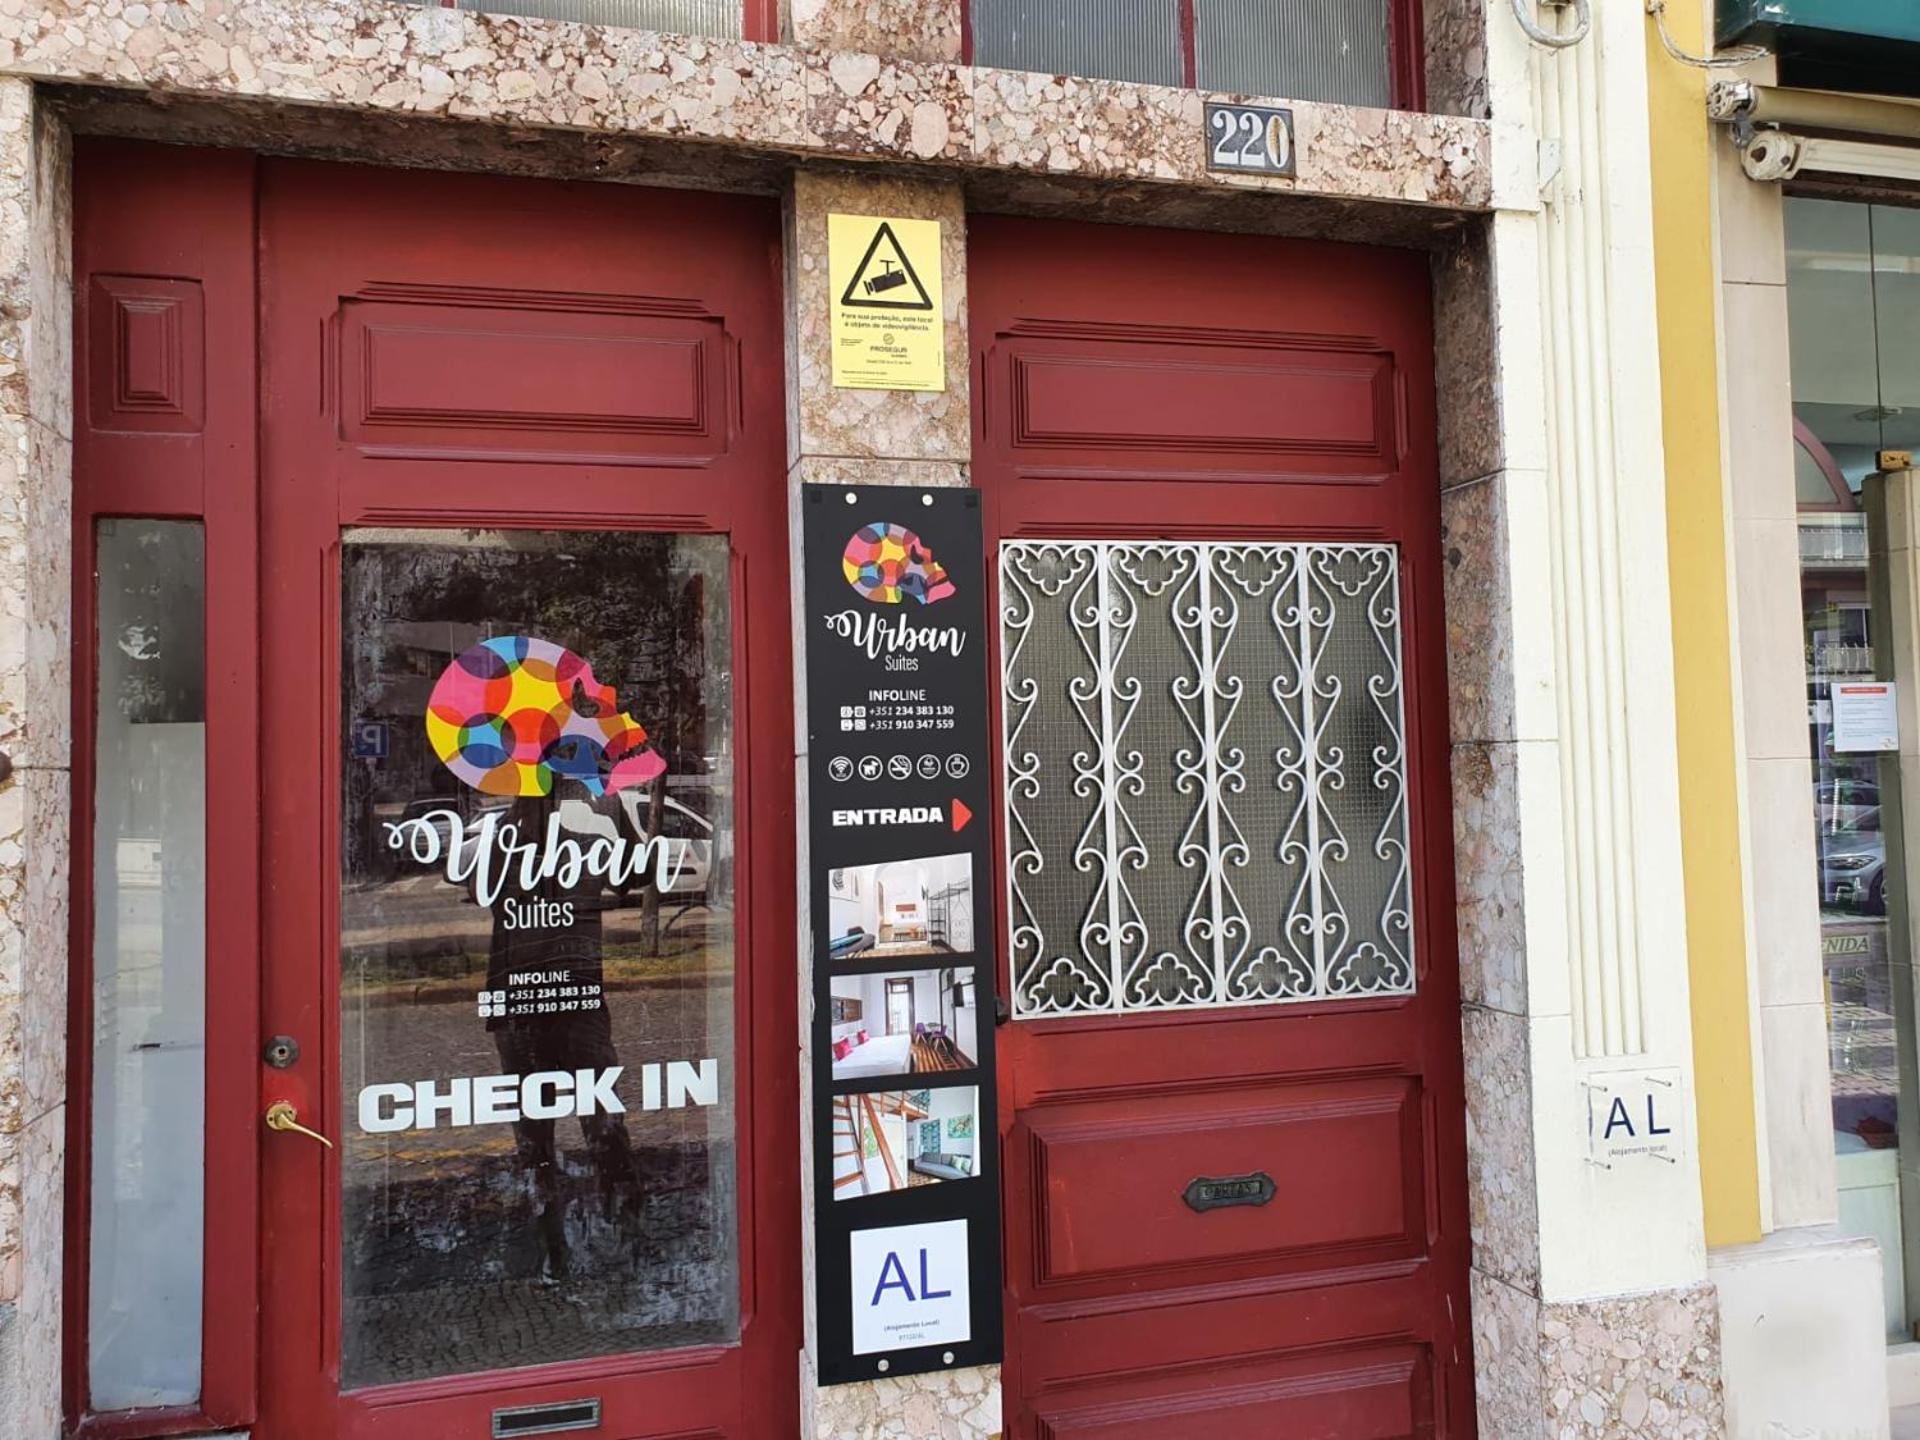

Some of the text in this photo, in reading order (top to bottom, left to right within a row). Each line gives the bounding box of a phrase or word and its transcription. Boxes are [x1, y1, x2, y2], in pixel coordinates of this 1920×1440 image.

[1212, 109, 1289, 168] 220
[824, 609, 966, 660] Urban
[885, 654, 919, 672] Suites
[868, 689, 927, 702] INFOLINE
[869, 705, 954, 716] +351 234 383 130
[869, 719, 954, 730] +351 910 347 559
[832, 807, 944, 827] ENTRADA
[382, 809, 687, 908] Urban
[503, 897, 575, 930] Suites
[1822, 937, 1869, 952] NIDA
[508, 970, 571, 986] INFOLINE
[509, 985, 601, 1000] +351 234 383 130
[509, 999, 601, 1015] +351 910 347 559
[358, 1058, 719, 1134] CHECK IN
[1604, 1093, 1671, 1139] AL
[870, 1248, 952, 1306] AL
